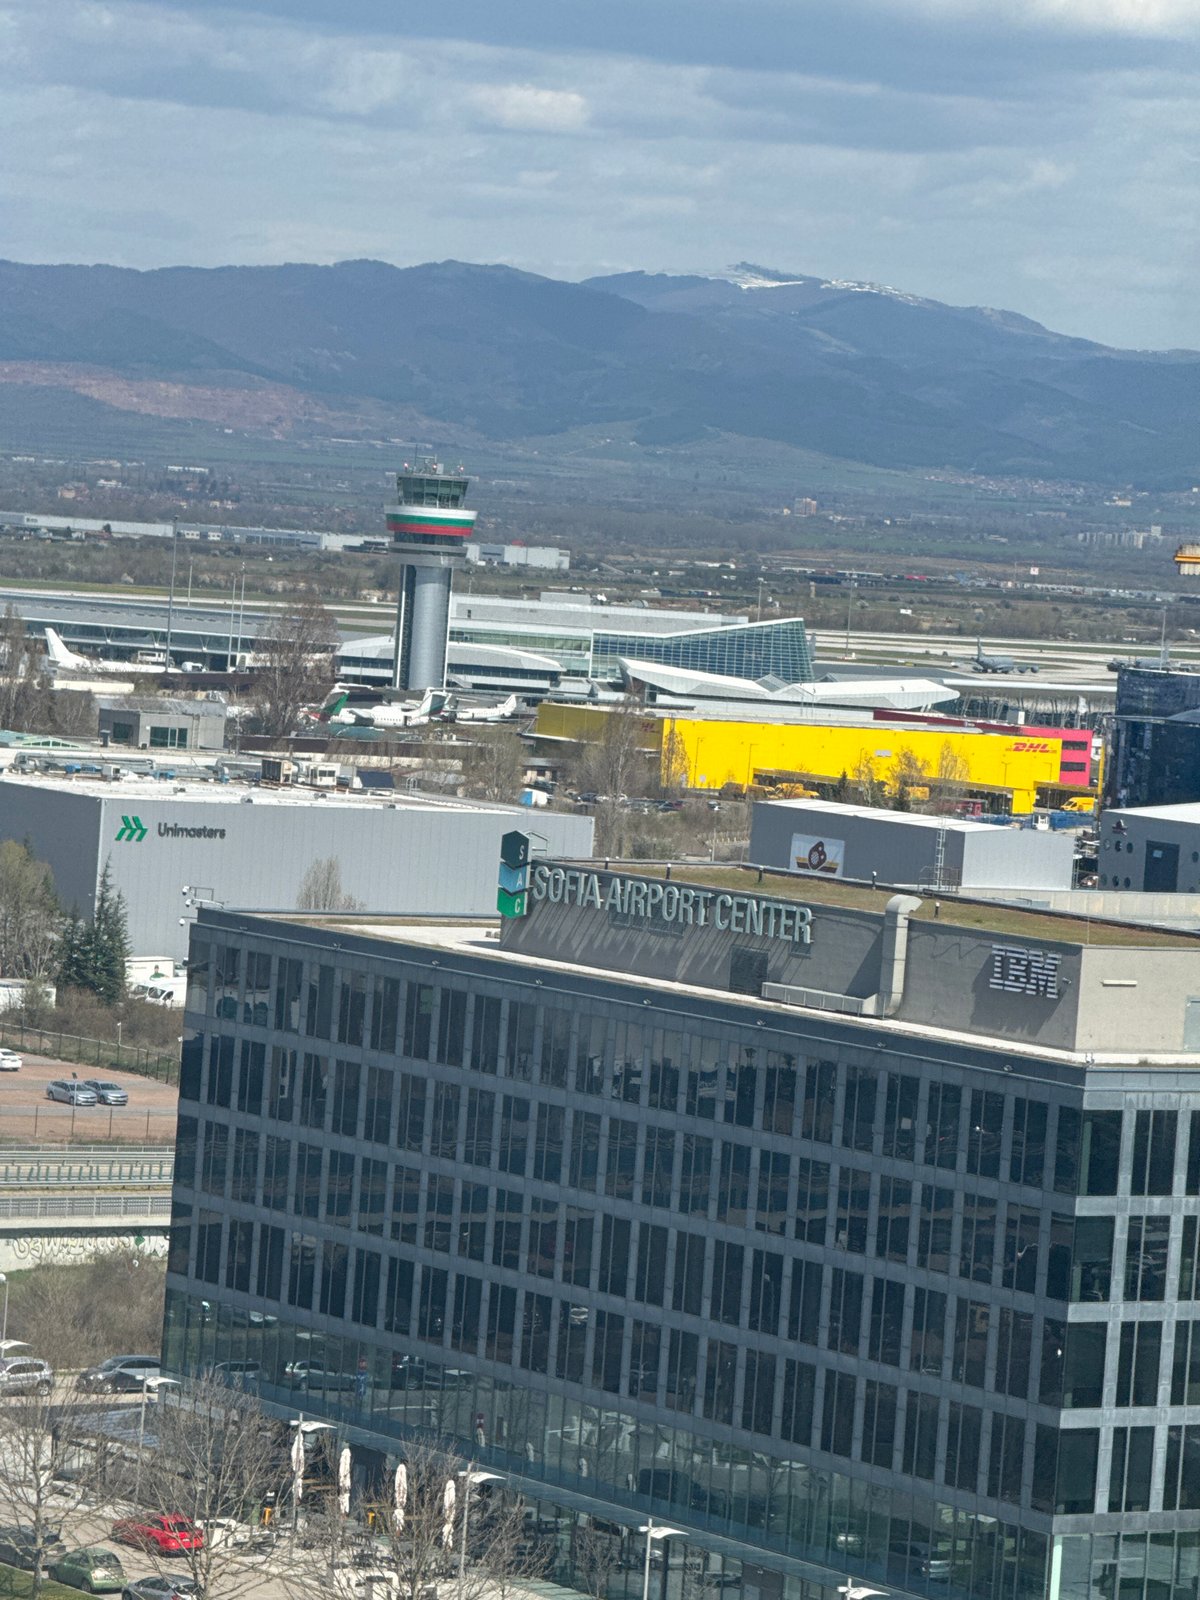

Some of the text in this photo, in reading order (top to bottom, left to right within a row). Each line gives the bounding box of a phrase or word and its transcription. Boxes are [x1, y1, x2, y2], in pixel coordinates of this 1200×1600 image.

[1012, 742, 1051, 753] DHL
[158, 822, 226, 839] Unimasters
[532, 866, 812, 944] SOFIA AIRPORT CENTER
[989, 944, 1060, 999] IBM
